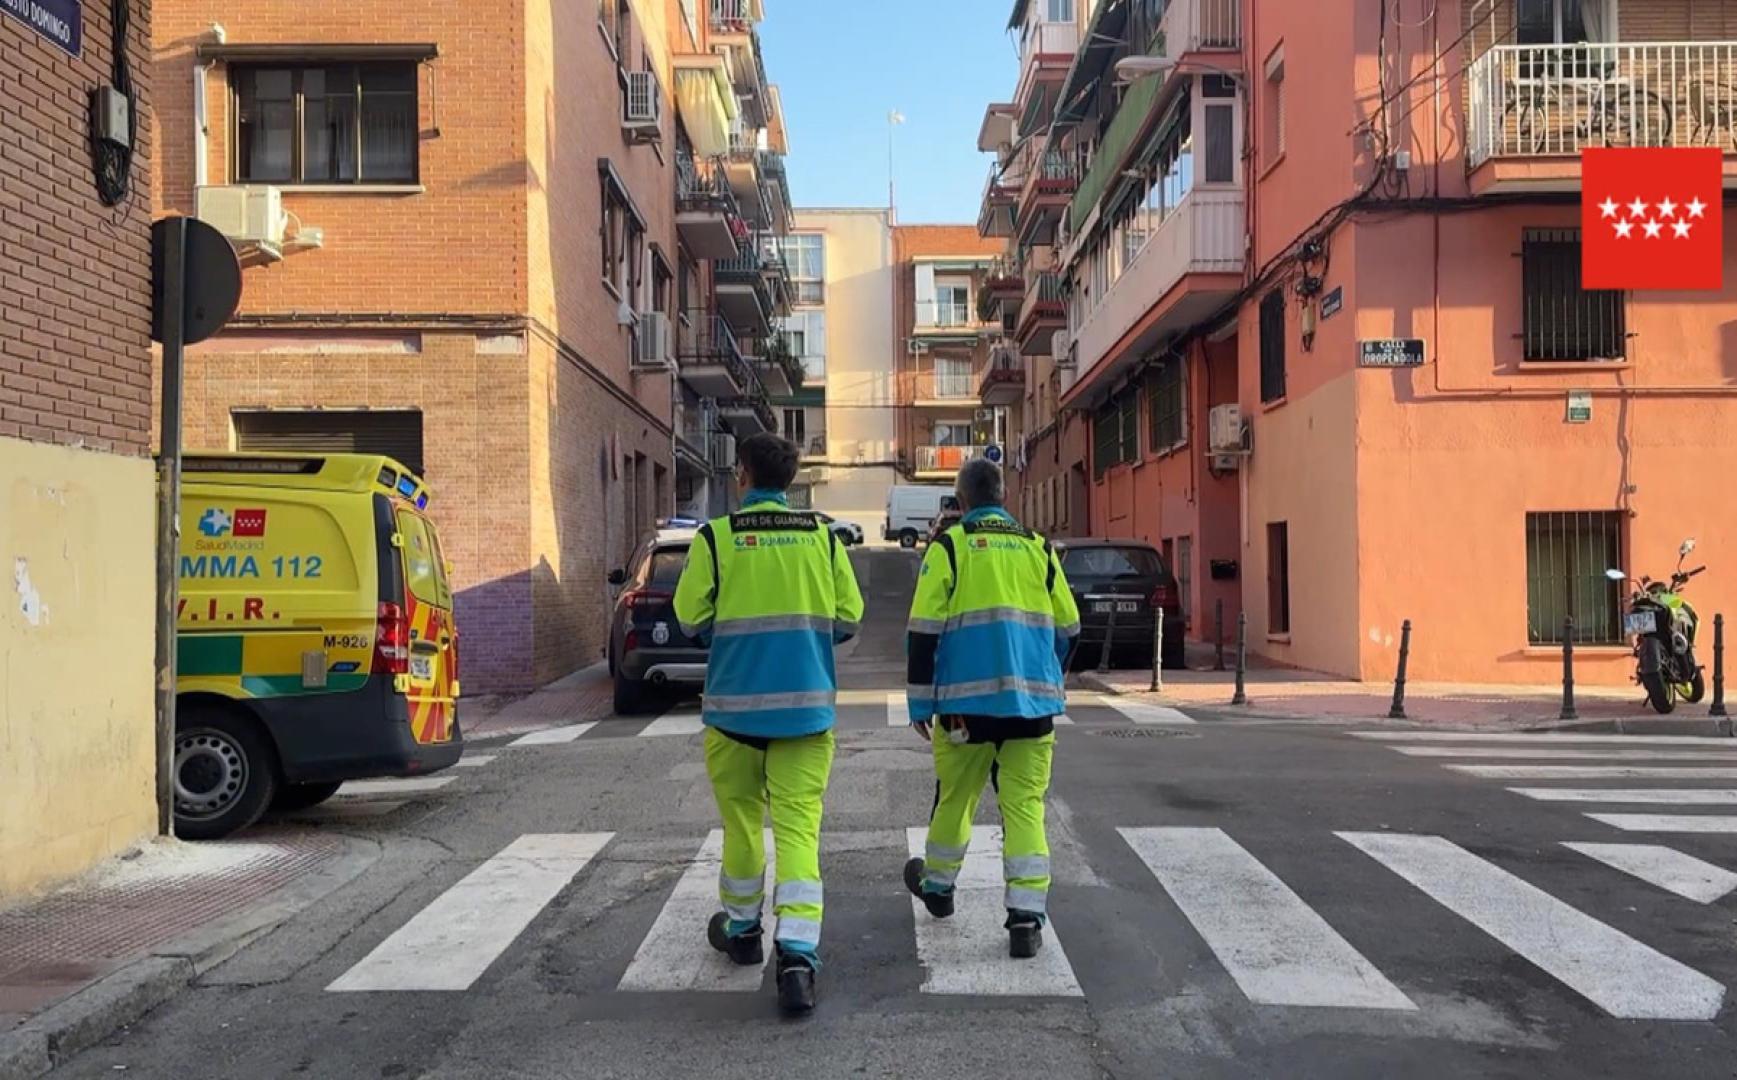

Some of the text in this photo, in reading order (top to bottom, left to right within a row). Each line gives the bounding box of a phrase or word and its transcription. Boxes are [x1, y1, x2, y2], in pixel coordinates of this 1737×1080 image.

[31, 1, 70, 43] DOMINGO
[1379, 340, 1406, 348] CALLE
[735, 514, 815, 527] JEFE DE GUARDIA
[272, 556, 322, 577] 112
[324, 635, 368, 648] M-926
